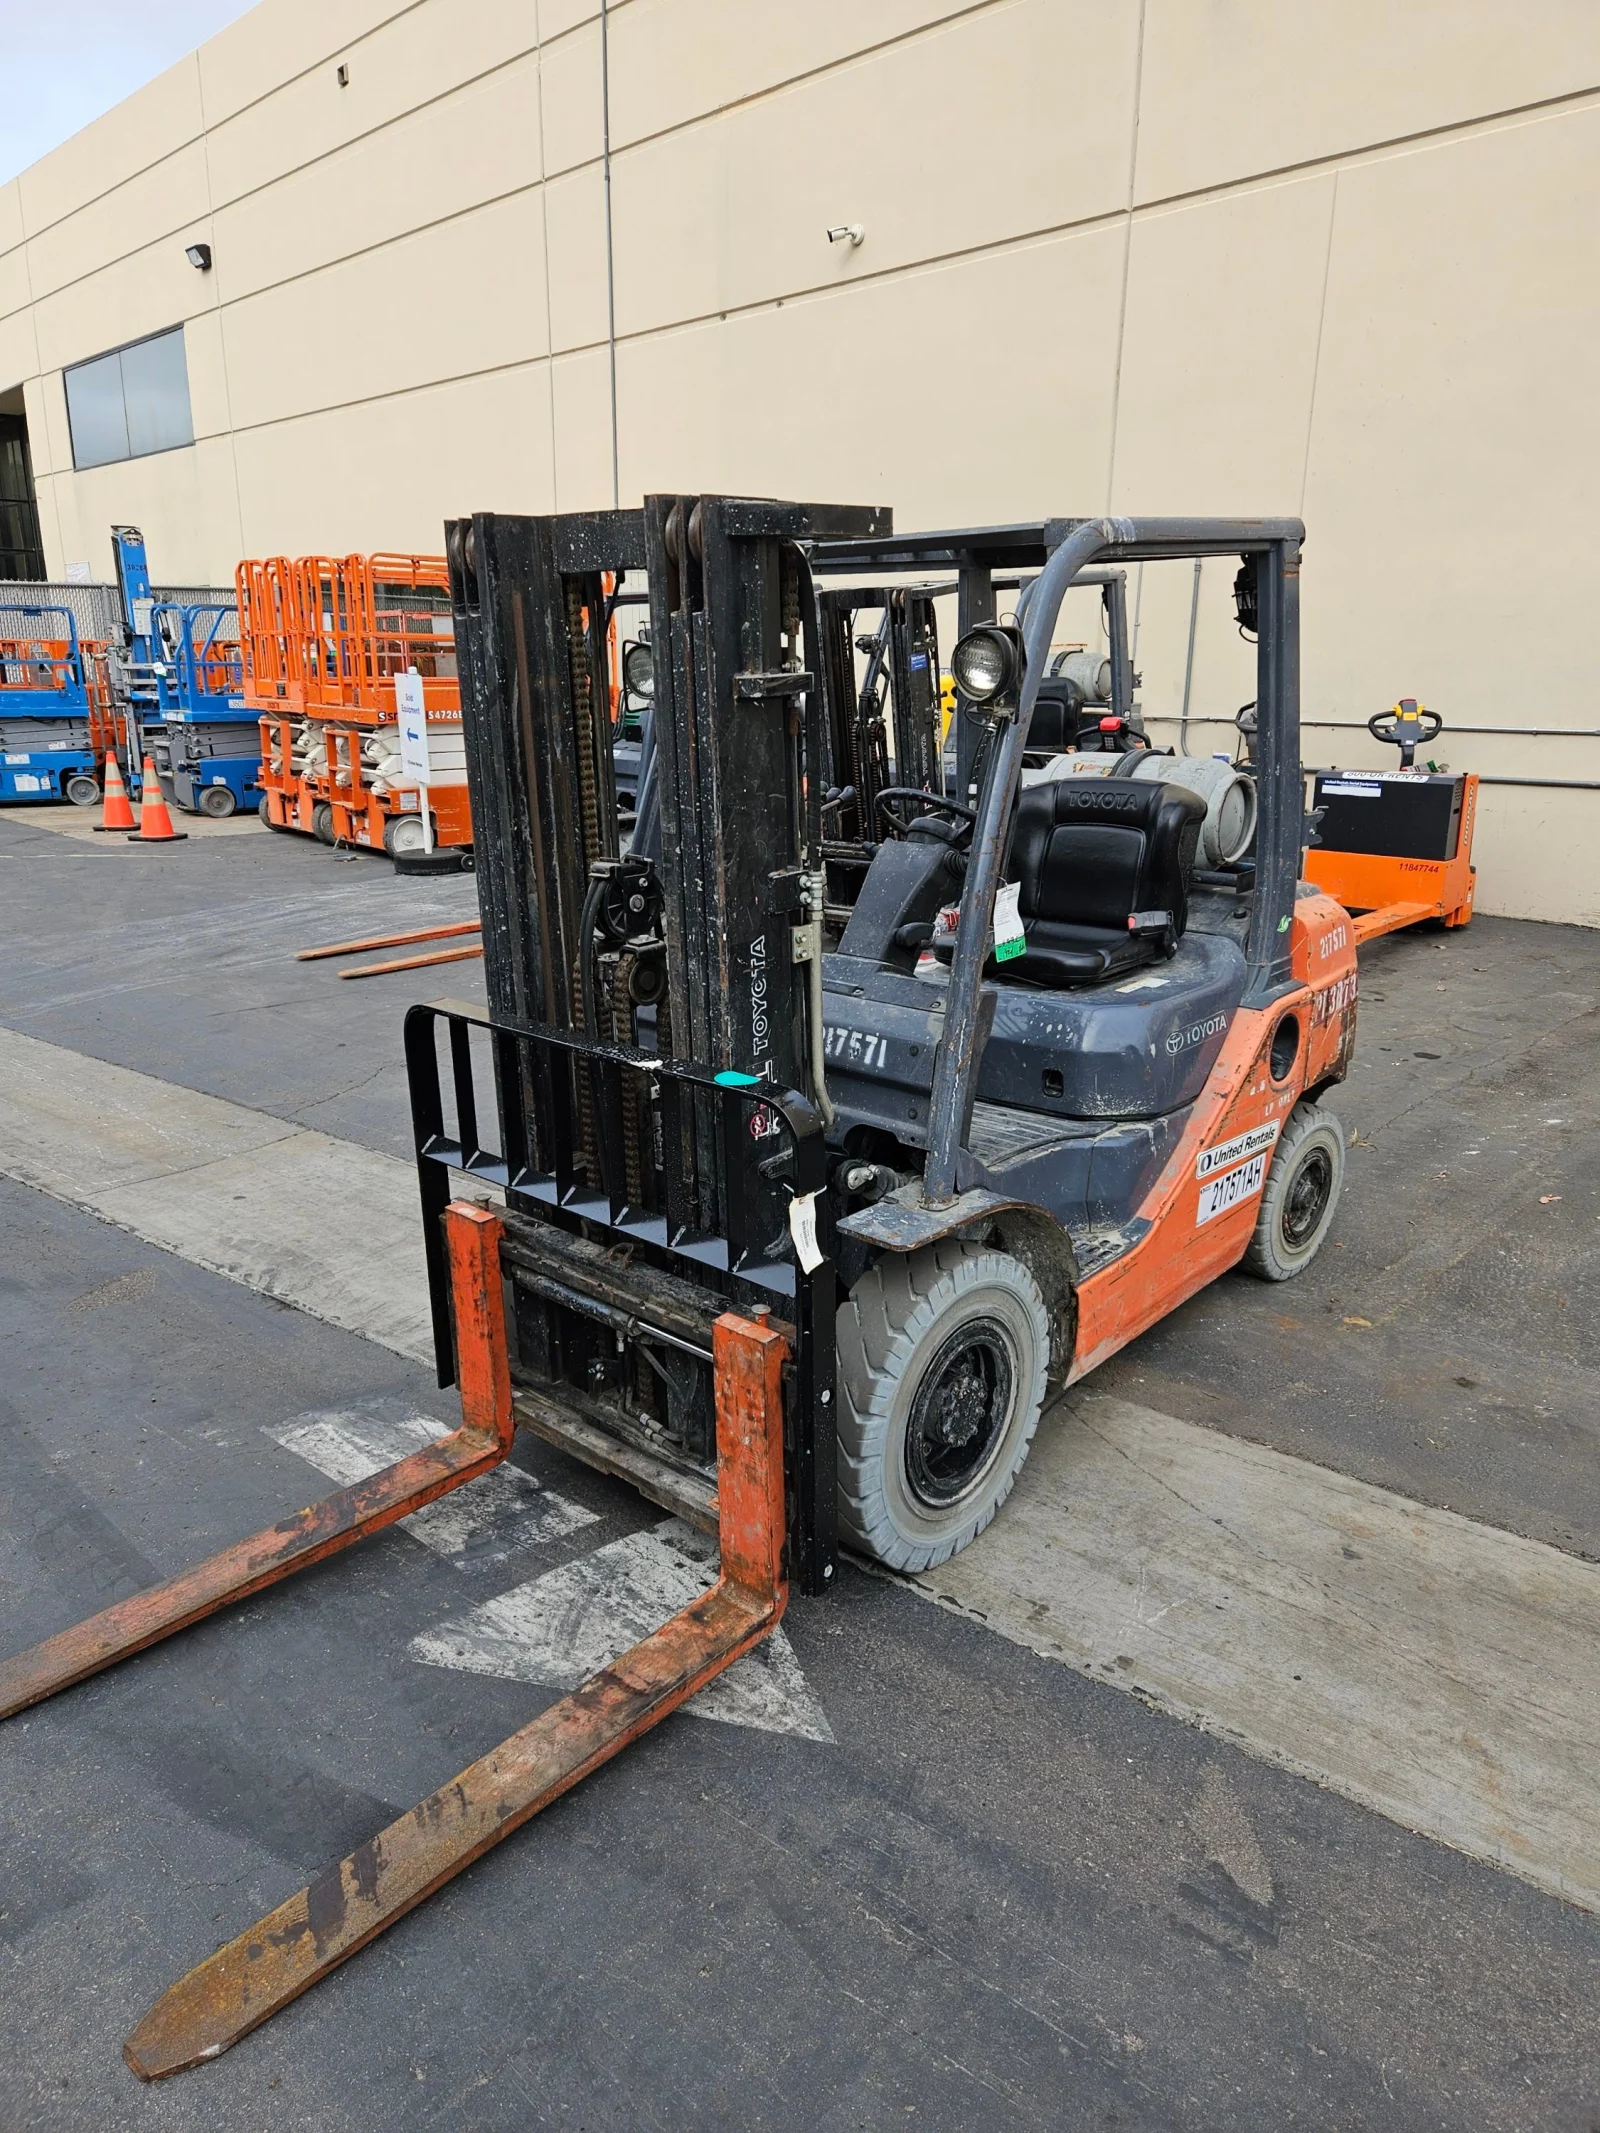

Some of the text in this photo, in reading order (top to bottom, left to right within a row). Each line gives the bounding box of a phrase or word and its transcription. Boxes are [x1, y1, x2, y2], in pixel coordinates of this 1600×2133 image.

[401, 704, 420, 714] Equipment
[405, 693, 413, 701] Sold
[428, 710, 463, 719] S4726E
[1068, 790, 1138, 811] TOYOTA
[1399, 863, 1439, 873] 11847744
[1320, 925, 1347, 959] 217571
[750, 935, 768, 1055] TOYOTA
[822, 1026, 888, 1068] 17571
[1213, 1127, 1276, 1166] United Rentals
[1210, 1156, 1263, 1212] 217571AH
